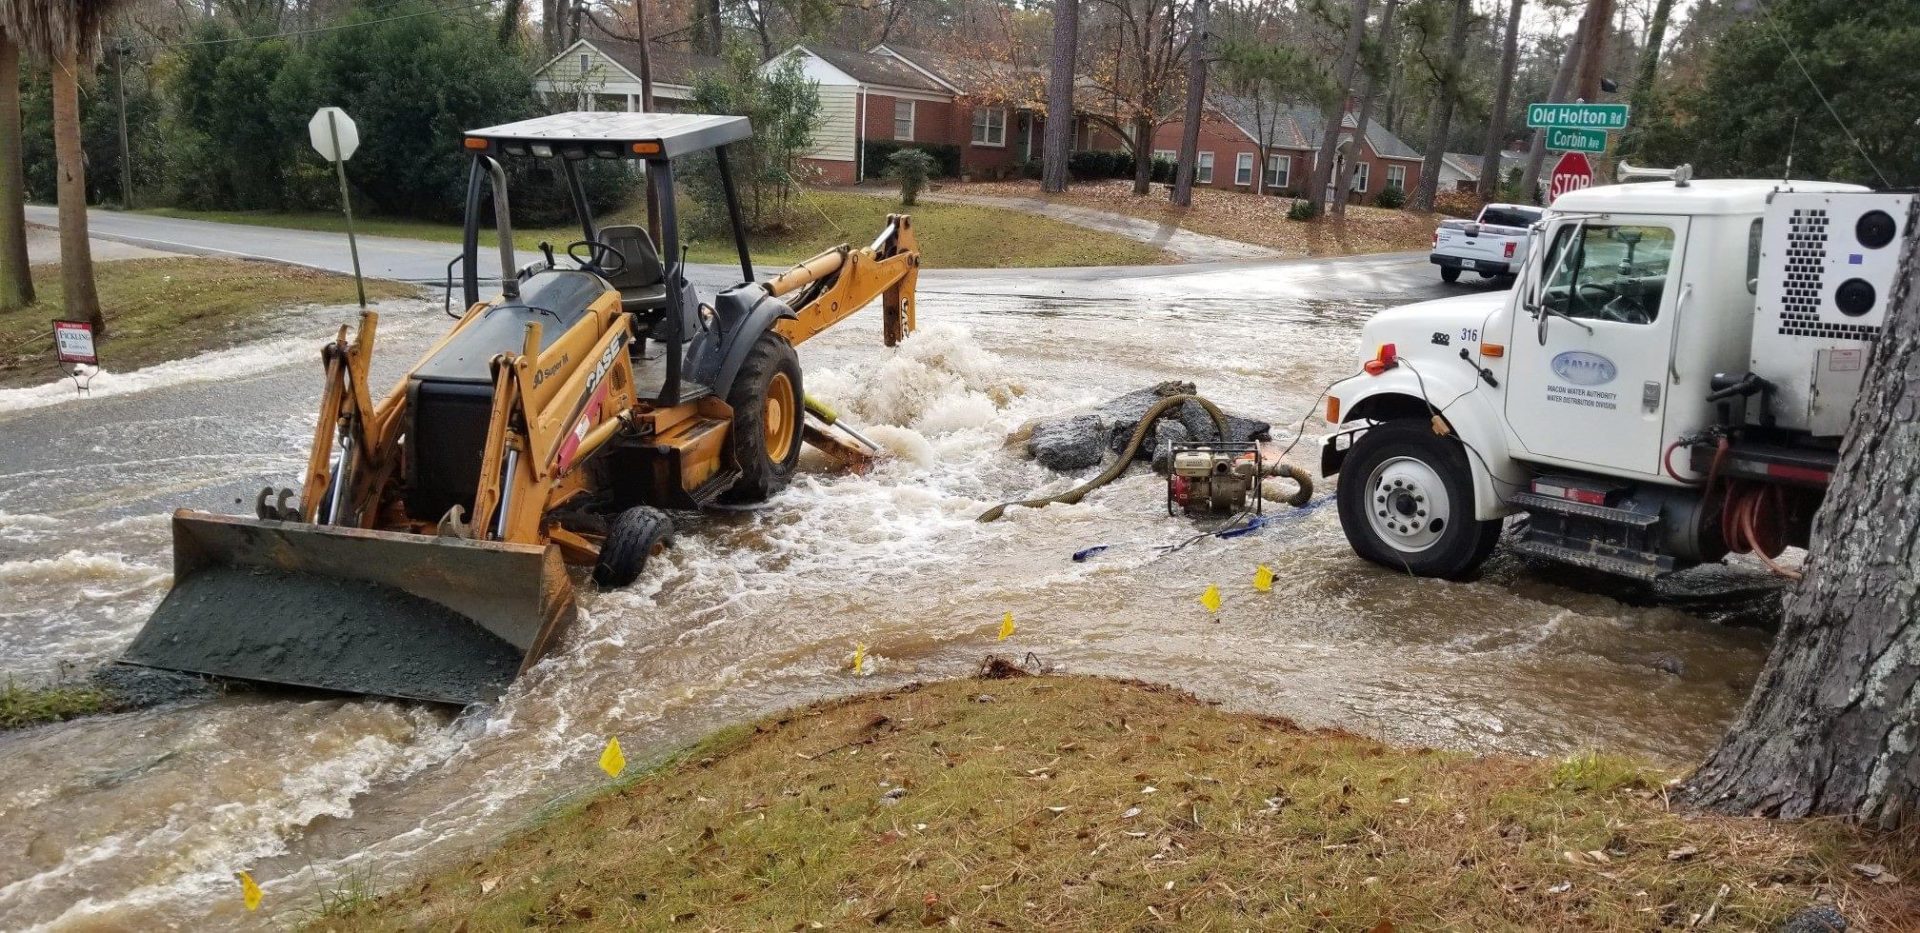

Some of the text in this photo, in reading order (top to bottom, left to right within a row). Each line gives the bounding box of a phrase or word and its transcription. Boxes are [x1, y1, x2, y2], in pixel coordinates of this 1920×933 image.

[1533, 107, 1622, 124] Old Holton Rd
[1553, 130, 1600, 149] Corbin Ave
[1551, 173, 1590, 198] STOP
[1460, 327, 1478, 342] 316
[543, 359, 562, 379] Super
[586, 333, 621, 393] CASE
[1547, 385, 1617, 400] MACON WATER AUTHORITY
[1547, 394, 1617, 410] WATER DISTRIBUTION DIVISION
